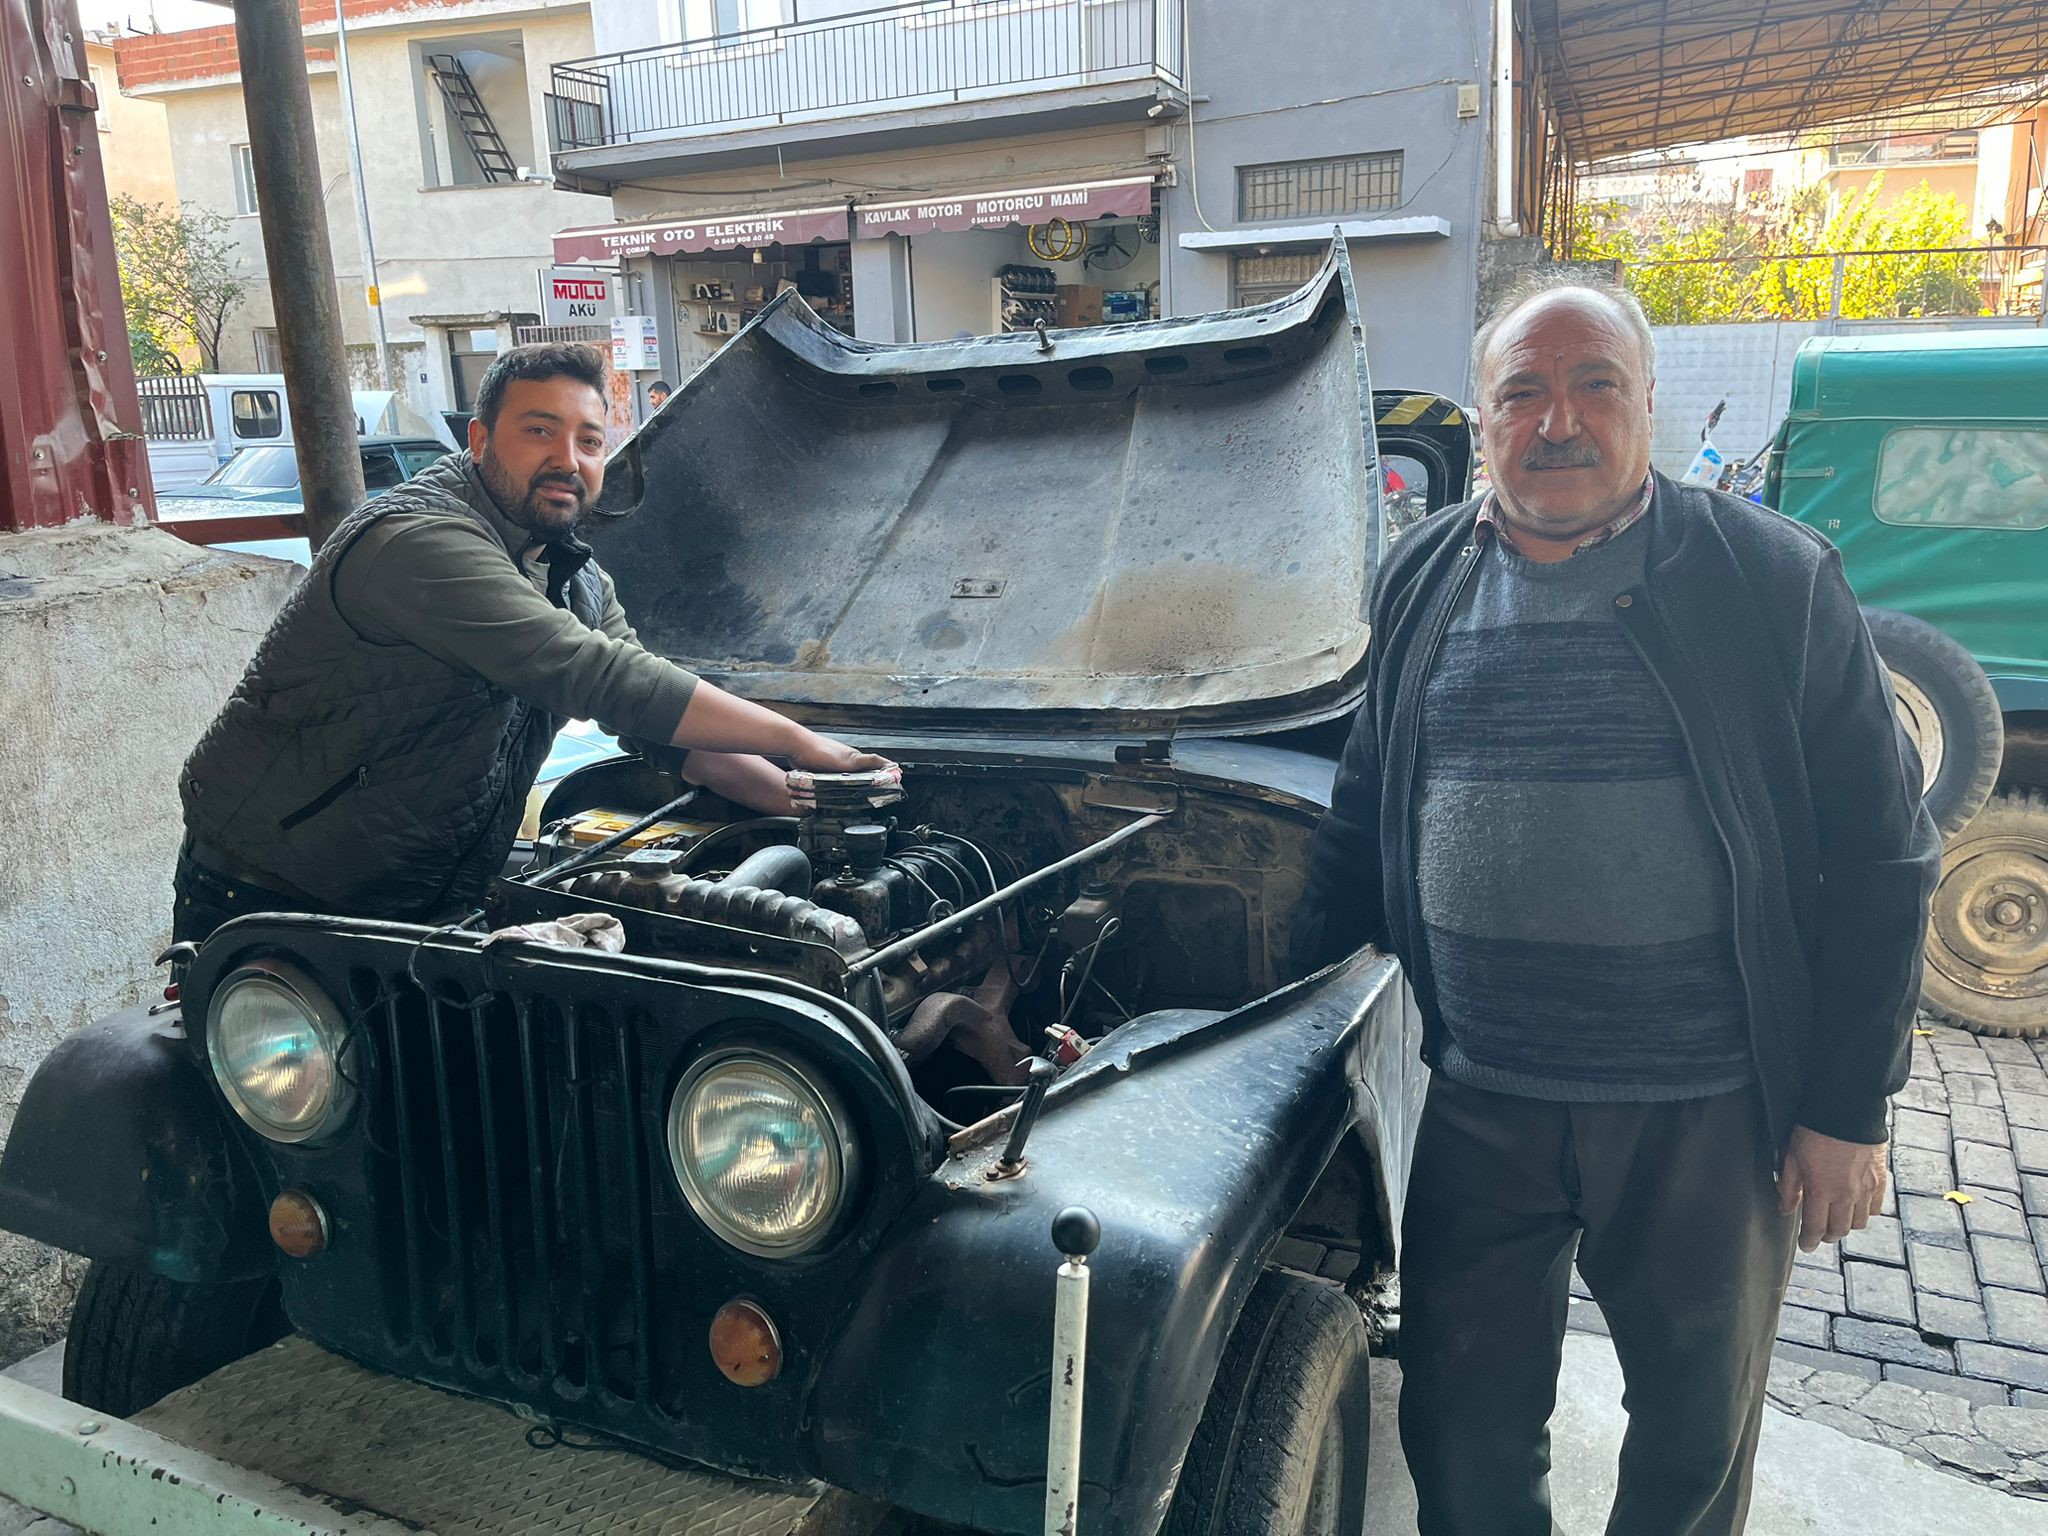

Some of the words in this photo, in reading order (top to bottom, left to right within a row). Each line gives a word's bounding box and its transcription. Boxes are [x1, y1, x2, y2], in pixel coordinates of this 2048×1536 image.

[864, 208, 911, 224] KAVLAK
[917, 204, 963, 219] MOTOR
[976, 195, 1044, 214] MOTORCU
[1051, 188, 1088, 207] MAMİ
[601, 231, 656, 247] TEKNİK
[663, 229, 695, 241] OTO
[706, 218, 784, 237] ELEKTRİK
[553, 279, 606, 300] MUTLU
[569, 304, 596, 317] AKÜ
